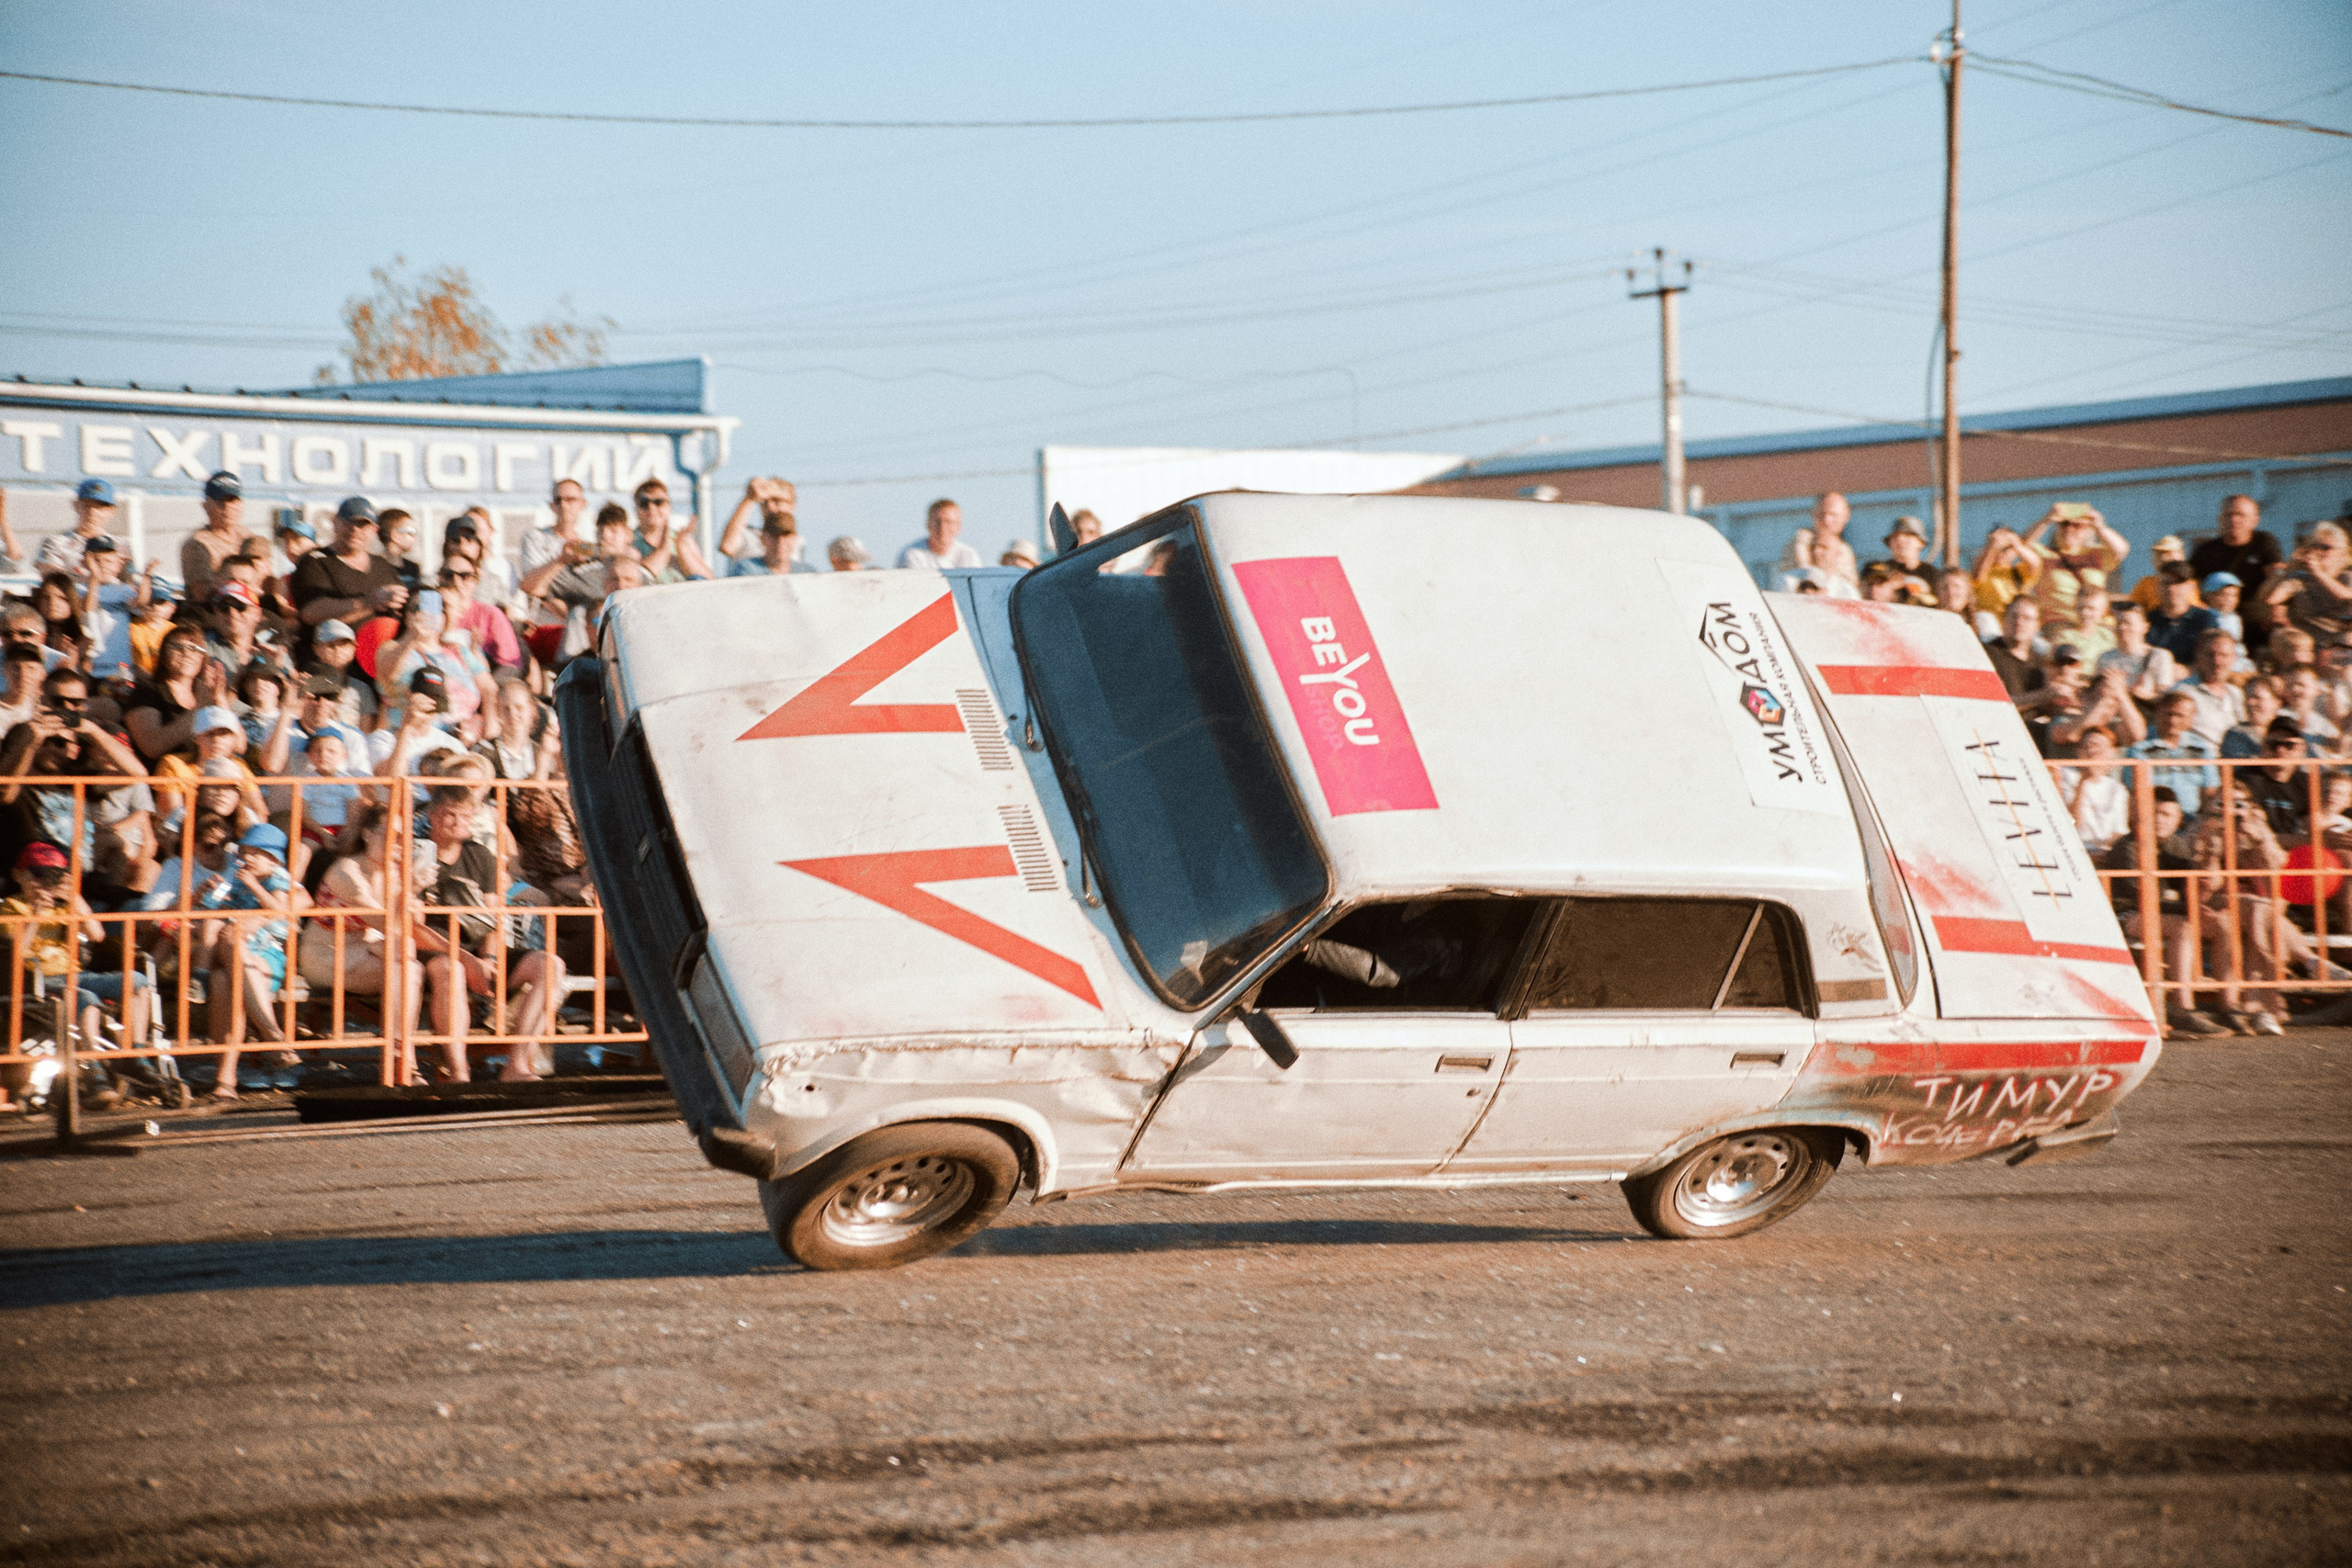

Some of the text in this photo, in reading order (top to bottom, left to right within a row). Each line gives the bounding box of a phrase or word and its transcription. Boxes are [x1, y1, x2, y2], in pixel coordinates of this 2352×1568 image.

[1, 420, 670, 492] ТЕХНОЛОГИЙ
[1964, 739, 2073, 897] LEVITA
[1914, 1071, 2115, 1122] ТИМУР
